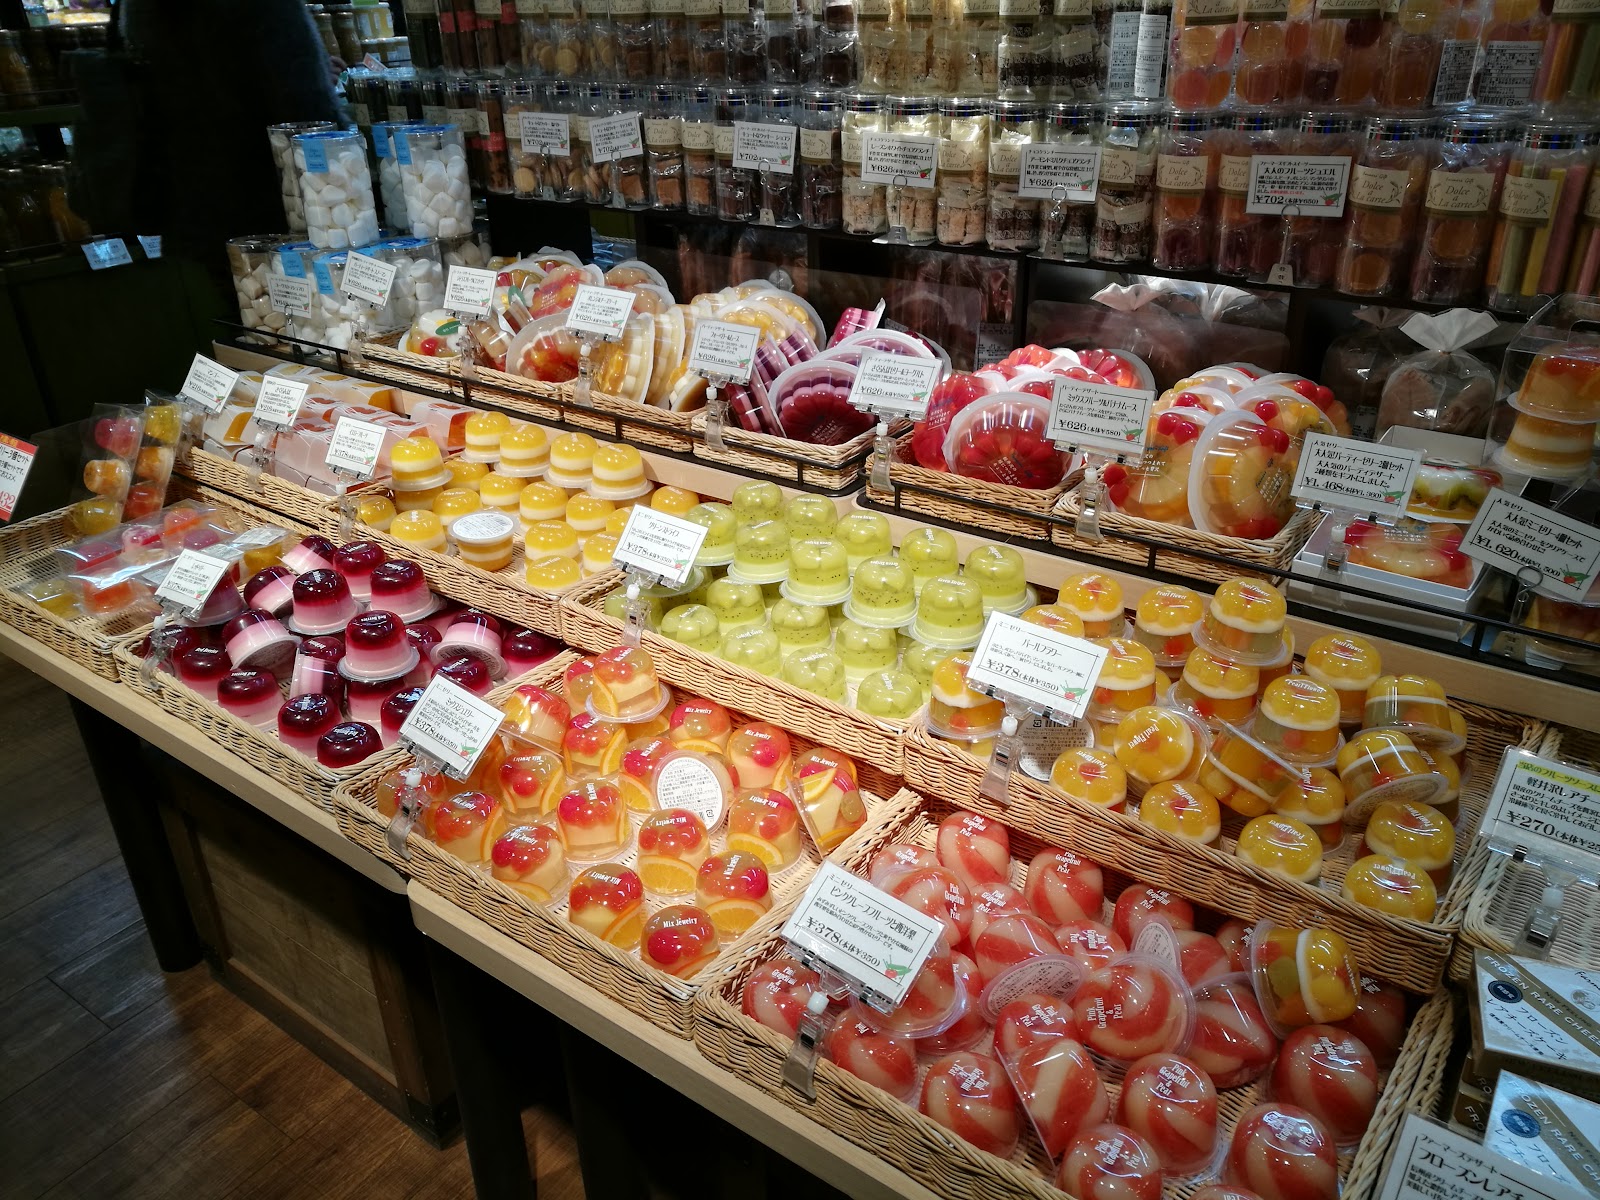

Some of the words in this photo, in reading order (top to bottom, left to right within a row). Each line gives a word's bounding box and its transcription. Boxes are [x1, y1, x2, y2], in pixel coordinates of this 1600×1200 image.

[1362, 180, 1384, 191] Dolce
[1445, 186, 1470, 196] Dolce
[1365, 195, 1385, 204] carte
[1438, 199, 1449, 207] La
[1450, 200, 1473, 209] carte
[1238, 580, 1254, 591] Pearl
[1253, 585, 1271, 597] Flower
[1331, 637, 1346, 646] Pearl
[1345, 642, 1365, 653] Flower
[985, 657, 1060, 692] ¥378(本体¥350)
[744, 729, 754, 737] Mix
[754, 731, 771, 740] Jewelry
[1145, 724, 1160, 740] Pearl
[1128, 734, 1146, 750] Flower
[811, 755, 820, 763] Mix
[820, 758, 838, 768] Jewelry
[749, 795, 768, 805] Jewelry
[768, 800, 779, 808] Mix
[656, 818, 676, 826] Jewelry
[962, 817, 986, 831] Grapefruit
[972, 815, 985, 824] Pink
[959, 828, 972, 837] Pear
[1267, 820, 1290, 834] Flower
[1287, 826, 1305, 840] Pearl
[1055, 854, 1081, 866] Grapefruit
[589, 871, 611, 882] Jewelry
[1056, 865, 1070, 874] Pear
[611, 877, 622, 885] Mix
[981, 892, 1006, 907] Grapefruit
[992, 890, 1005, 899] Pink
[828, 884, 918, 941] ピンクグレープフルーツと西洋梨
[977, 902, 991, 913] Pear
[663, 920, 675, 928] Mix
[676, 917, 698, 926] Jewelry
[803, 915, 883, 968] ¥378(本体¥350)
[1484, 955, 1529, 990] FROZEN
[1530, 991, 1563, 1015] RARE
[1087, 1007, 1097, 1021] Pink
[1097, 997, 1106, 1029] Grapefruit
[1113, 1003, 1123, 1020] Pear
[1486, 998, 1568, 1060] レアチーズケーキ
[1516, 1006, 1569, 1046] フローズン
[1158, 1065, 1192, 1089] Grapefruit
[1172, 1063, 1188, 1077] Pink
[1155, 1082, 1173, 1097] Pear
[1508, 1080, 1552, 1126] FROZEN
[1551, 1129, 1584, 1160] RARE
